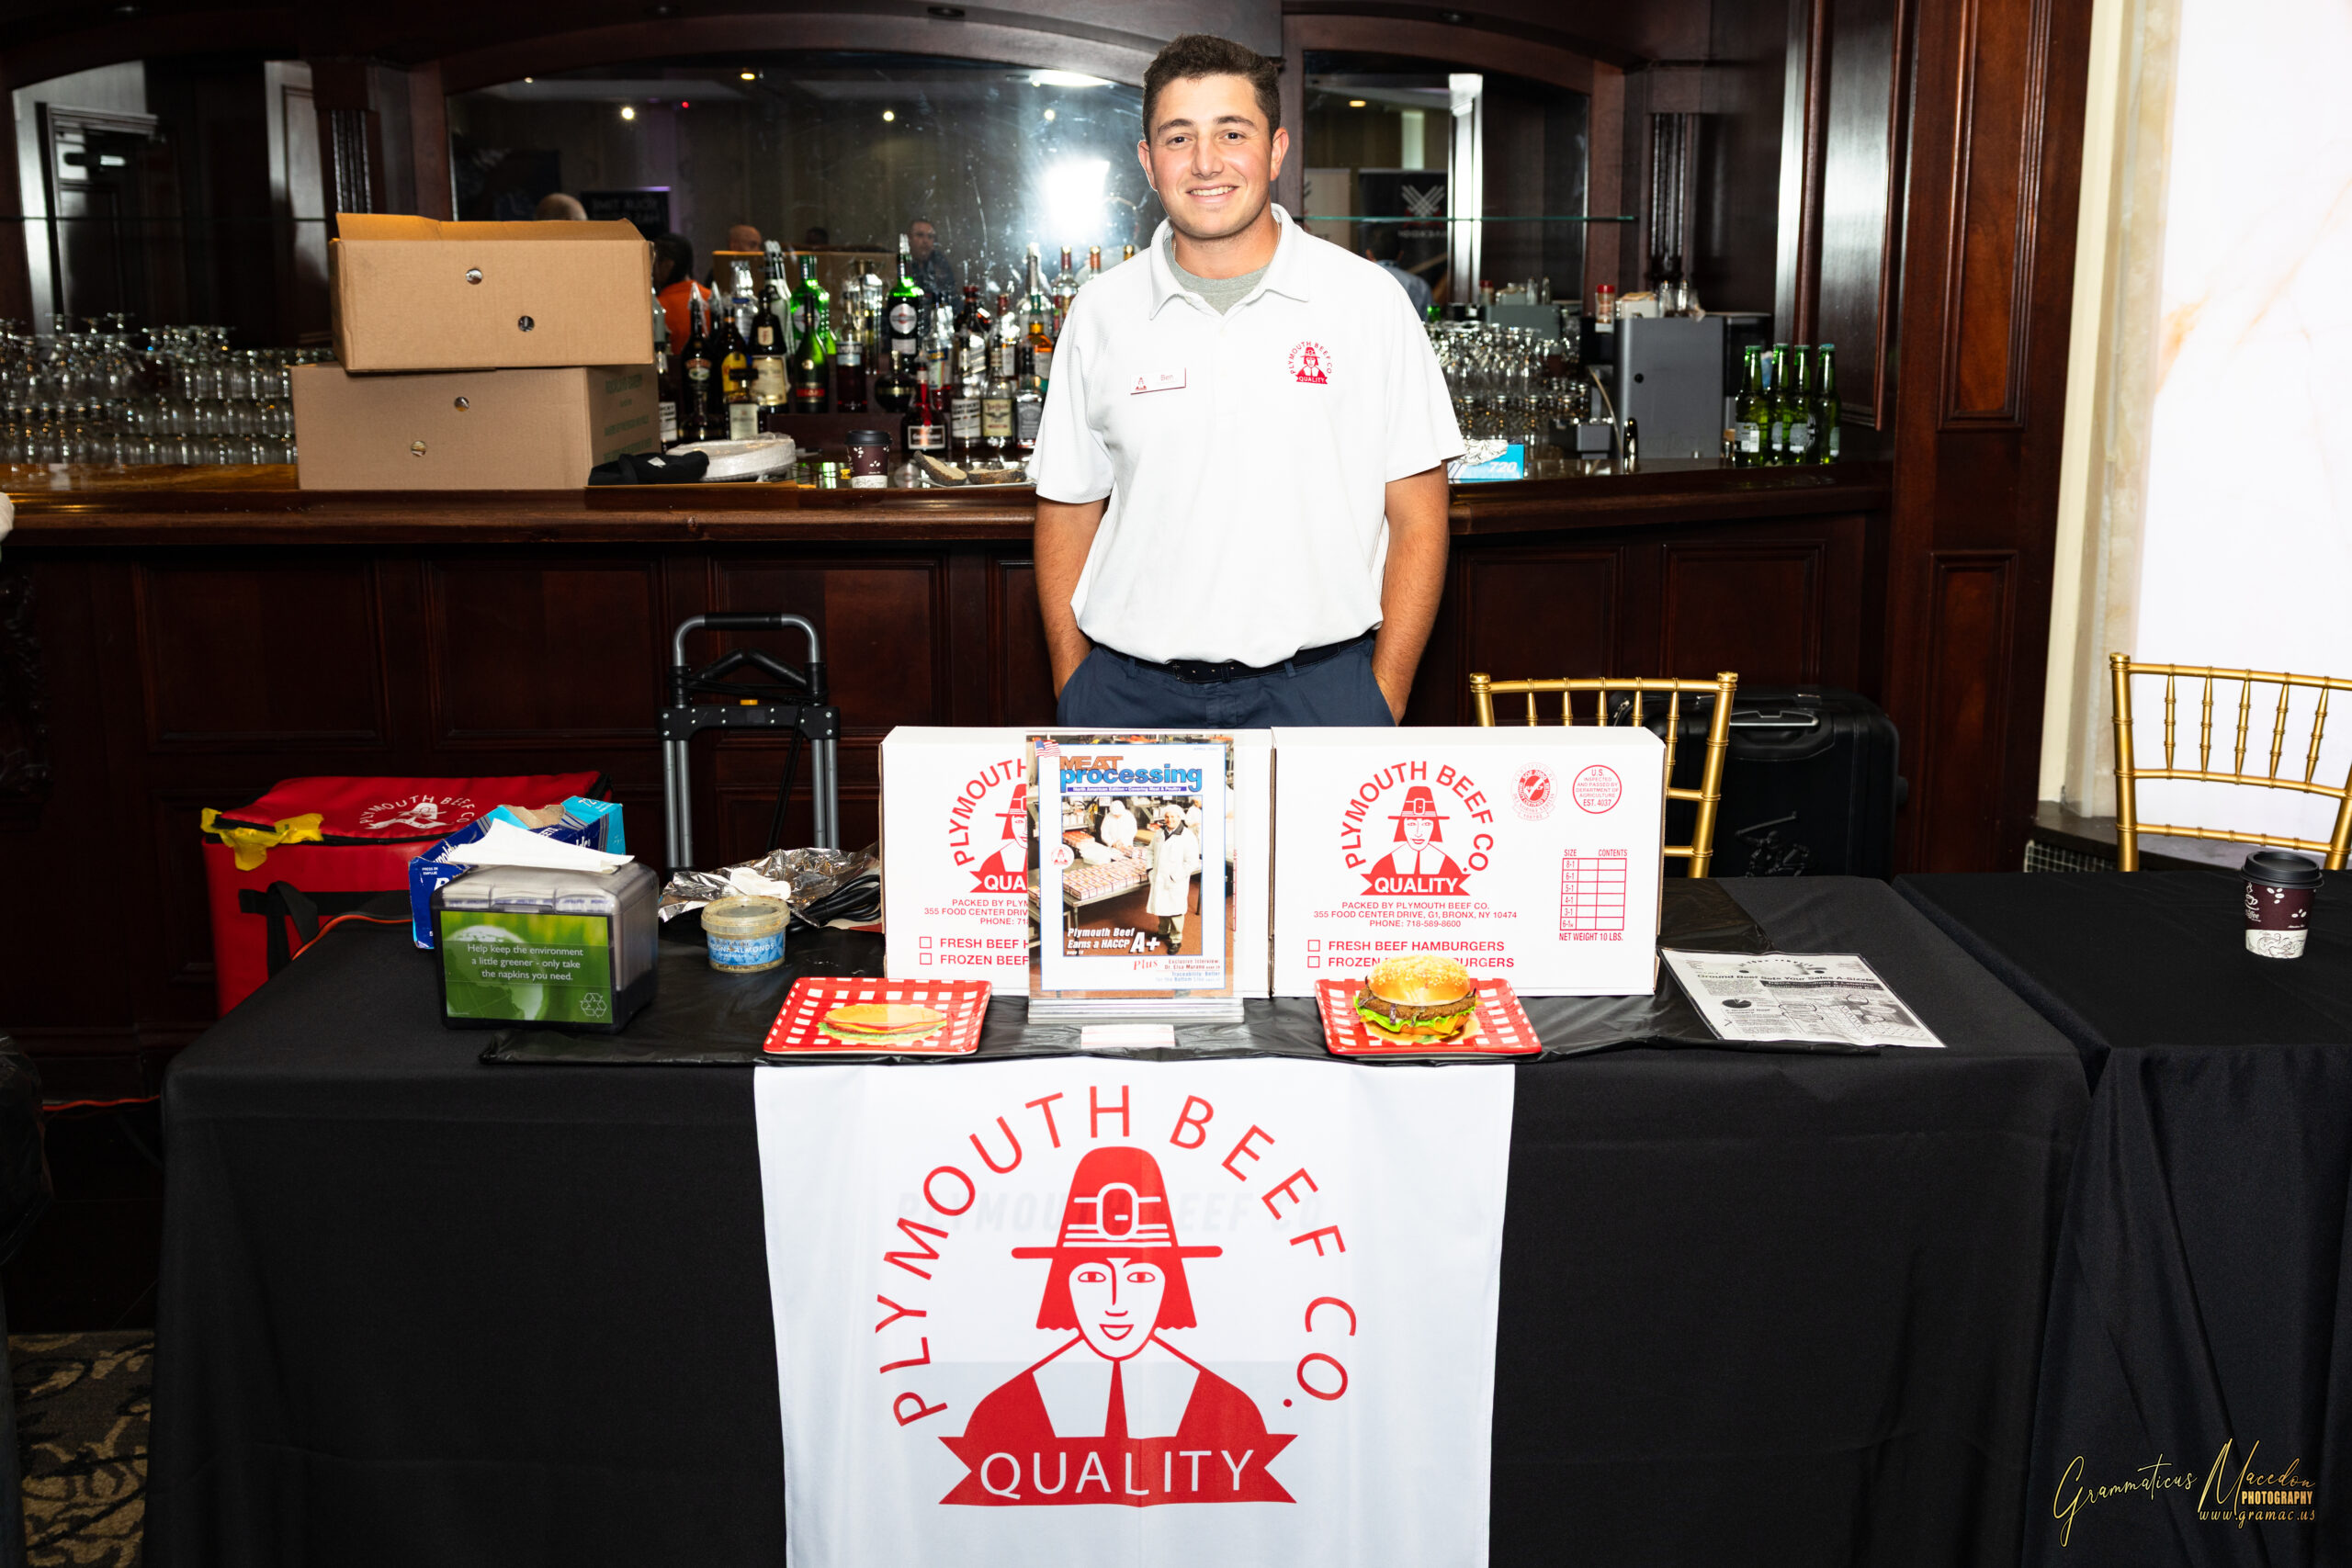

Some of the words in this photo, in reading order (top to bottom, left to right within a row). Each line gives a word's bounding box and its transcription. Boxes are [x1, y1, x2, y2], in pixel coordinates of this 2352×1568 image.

[1288, 342, 1311, 374] PLYMOUTH
[1315, 343, 1331, 359] BEEF
[1489, 461, 1518, 473] 720
[1059, 755, 1124, 772] MEAT
[1059, 763, 1203, 793] processing
[1436, 764, 1494, 824] BEEF
[440, 796, 476, 809] BEEF
[359, 795, 435, 824] PLYMOUTH
[1340, 761, 1427, 869] PLYMOUTH
[456, 811, 475, 823] CO
[1463, 833, 1494, 872] CO.
[1564, 849, 1577, 857] SIZE
[1598, 849, 1628, 857] CONTENTS
[1566, 860, 1575, 868] 8-1
[1566, 872, 1575, 880] 6-1
[983, 874, 1027, 891] QUA
[1374, 876, 1459, 894] QUALITY
[1565, 884, 1574, 892] 5-1
[942, 908, 967, 916] FOOD
[1564, 908, 1573, 916] 3-1
[1067, 928, 1111, 938] Plymouth
[1113, 928, 1135, 937] Beef
[1559, 932, 1571, 941] NET
[1573, 932, 1599, 942] WEIGHT
[1600, 932, 1608, 941] 10
[1609, 932, 1623, 942] LBS.
[735, 943, 775, 953] ALMONDS
[940, 938, 982, 948] FRESH
[987, 939, 1019, 949] BEEF
[1067, 939, 1091, 949] Earns
[1092, 941, 1099, 949] a
[1101, 939, 1130, 949] HACCP
[1130, 931, 1160, 953] A+
[1329, 941, 1371, 951] FRESH
[1375, 942, 1408, 951] BEEF
[1411, 942, 1505, 952] HAMBURGERS
[467, 944, 488, 954] Help
[490, 944, 511, 955] keep
[513, 945, 527, 954] the
[529, 947, 583, 956] environment
[479, 957, 498, 965] little
[500, 959, 533, 968] greener
[541, 960, 560, 970] only
[562, 961, 581, 969] take
[940, 954, 992, 964] FROZEN
[997, 955, 1028, 965] BEEF
[1133, 959, 1159, 970] Plus
[1329, 957, 1380, 967] FROZEN
[481, 970, 496, 978] the
[498, 970, 529, 980] napkins
[532, 973, 548, 983] you
[549, 972, 573, 981] need.
[875, 1084, 1130, 1427] PLYMOUTH
[1170, 1094, 1347, 1257] BEEF
[1283, 1296, 1357, 1408] CO.
[979, 1449, 1255, 1500] QUALITY
